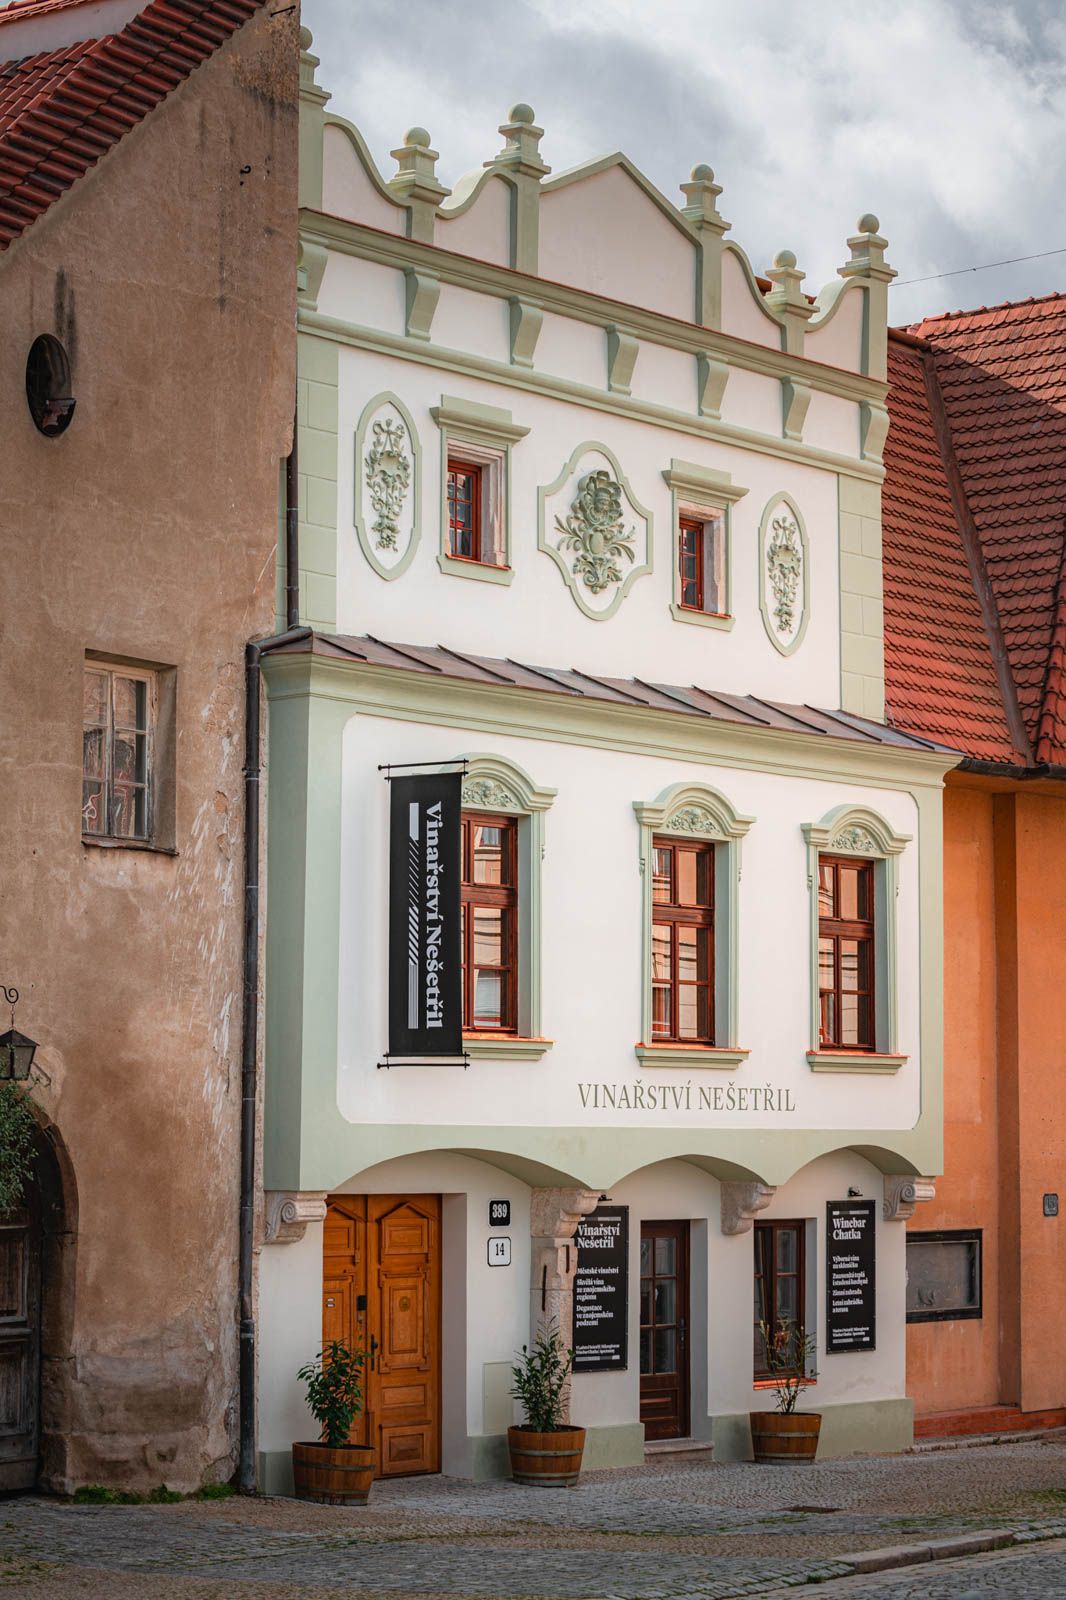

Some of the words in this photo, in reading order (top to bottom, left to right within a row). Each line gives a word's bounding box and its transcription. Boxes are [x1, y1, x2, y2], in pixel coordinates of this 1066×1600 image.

[426, 800, 443, 922] Vinařství
[426, 925, 443, 1029] Nešetřil
[578, 1079, 691, 1110] VINAŘSTVÍ
[699, 1081, 796, 1112] NEŠETŘIL
[492, 1203, 508, 1218] 389
[833, 1217, 866, 1228] Winebar
[578, 1223, 620, 1236] Vinařství
[833, 1229, 861, 1240] Chatka
[577, 1236, 614, 1248] Nešetřil
[495, 1243, 505, 1256] 14
[598, 1266, 619, 1274] vinařství
[576, 1293, 597, 1302] regionu
[576, 1318, 599, 1328] podzemí
